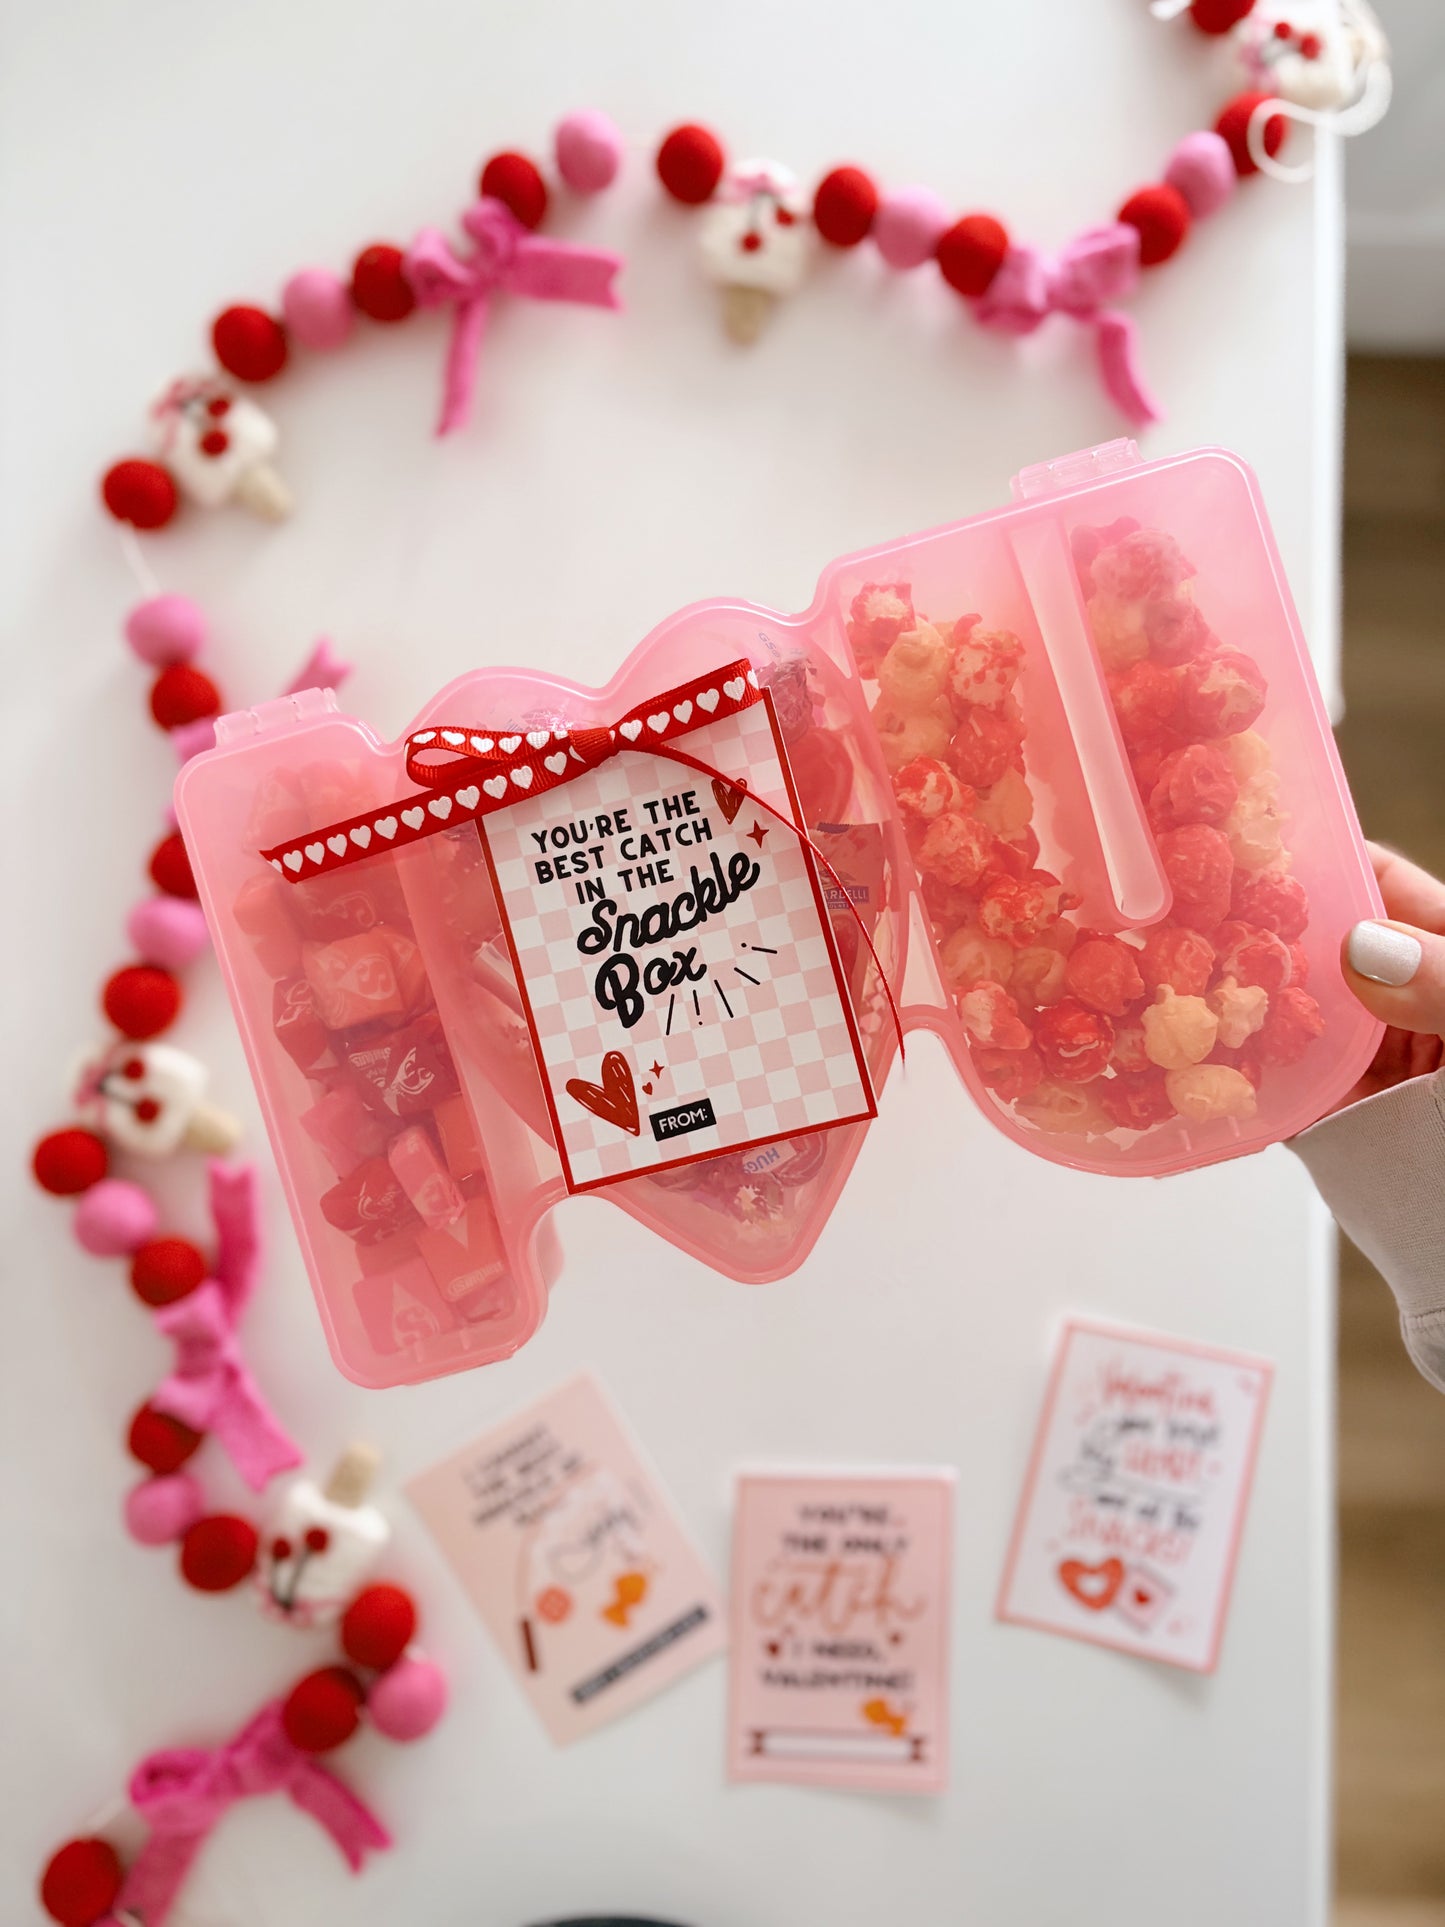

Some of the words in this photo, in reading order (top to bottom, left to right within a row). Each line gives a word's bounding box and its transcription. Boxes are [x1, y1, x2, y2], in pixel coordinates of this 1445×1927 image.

[531, 808, 631, 853] YOU'RE
[643, 790, 701, 825] THE
[534, 848, 605, 884] BEST
[619, 819, 714, 861] CATCH
[575, 876, 607, 904] IN
[618, 859, 675, 894] THE
[576, 850, 761, 955] Snackle
[594, 946, 708, 1029] Box
[658, 1108, 709, 1133] FROM:
[782, 1534, 828, 1555] THE
[750, 1555, 928, 1633] catch
